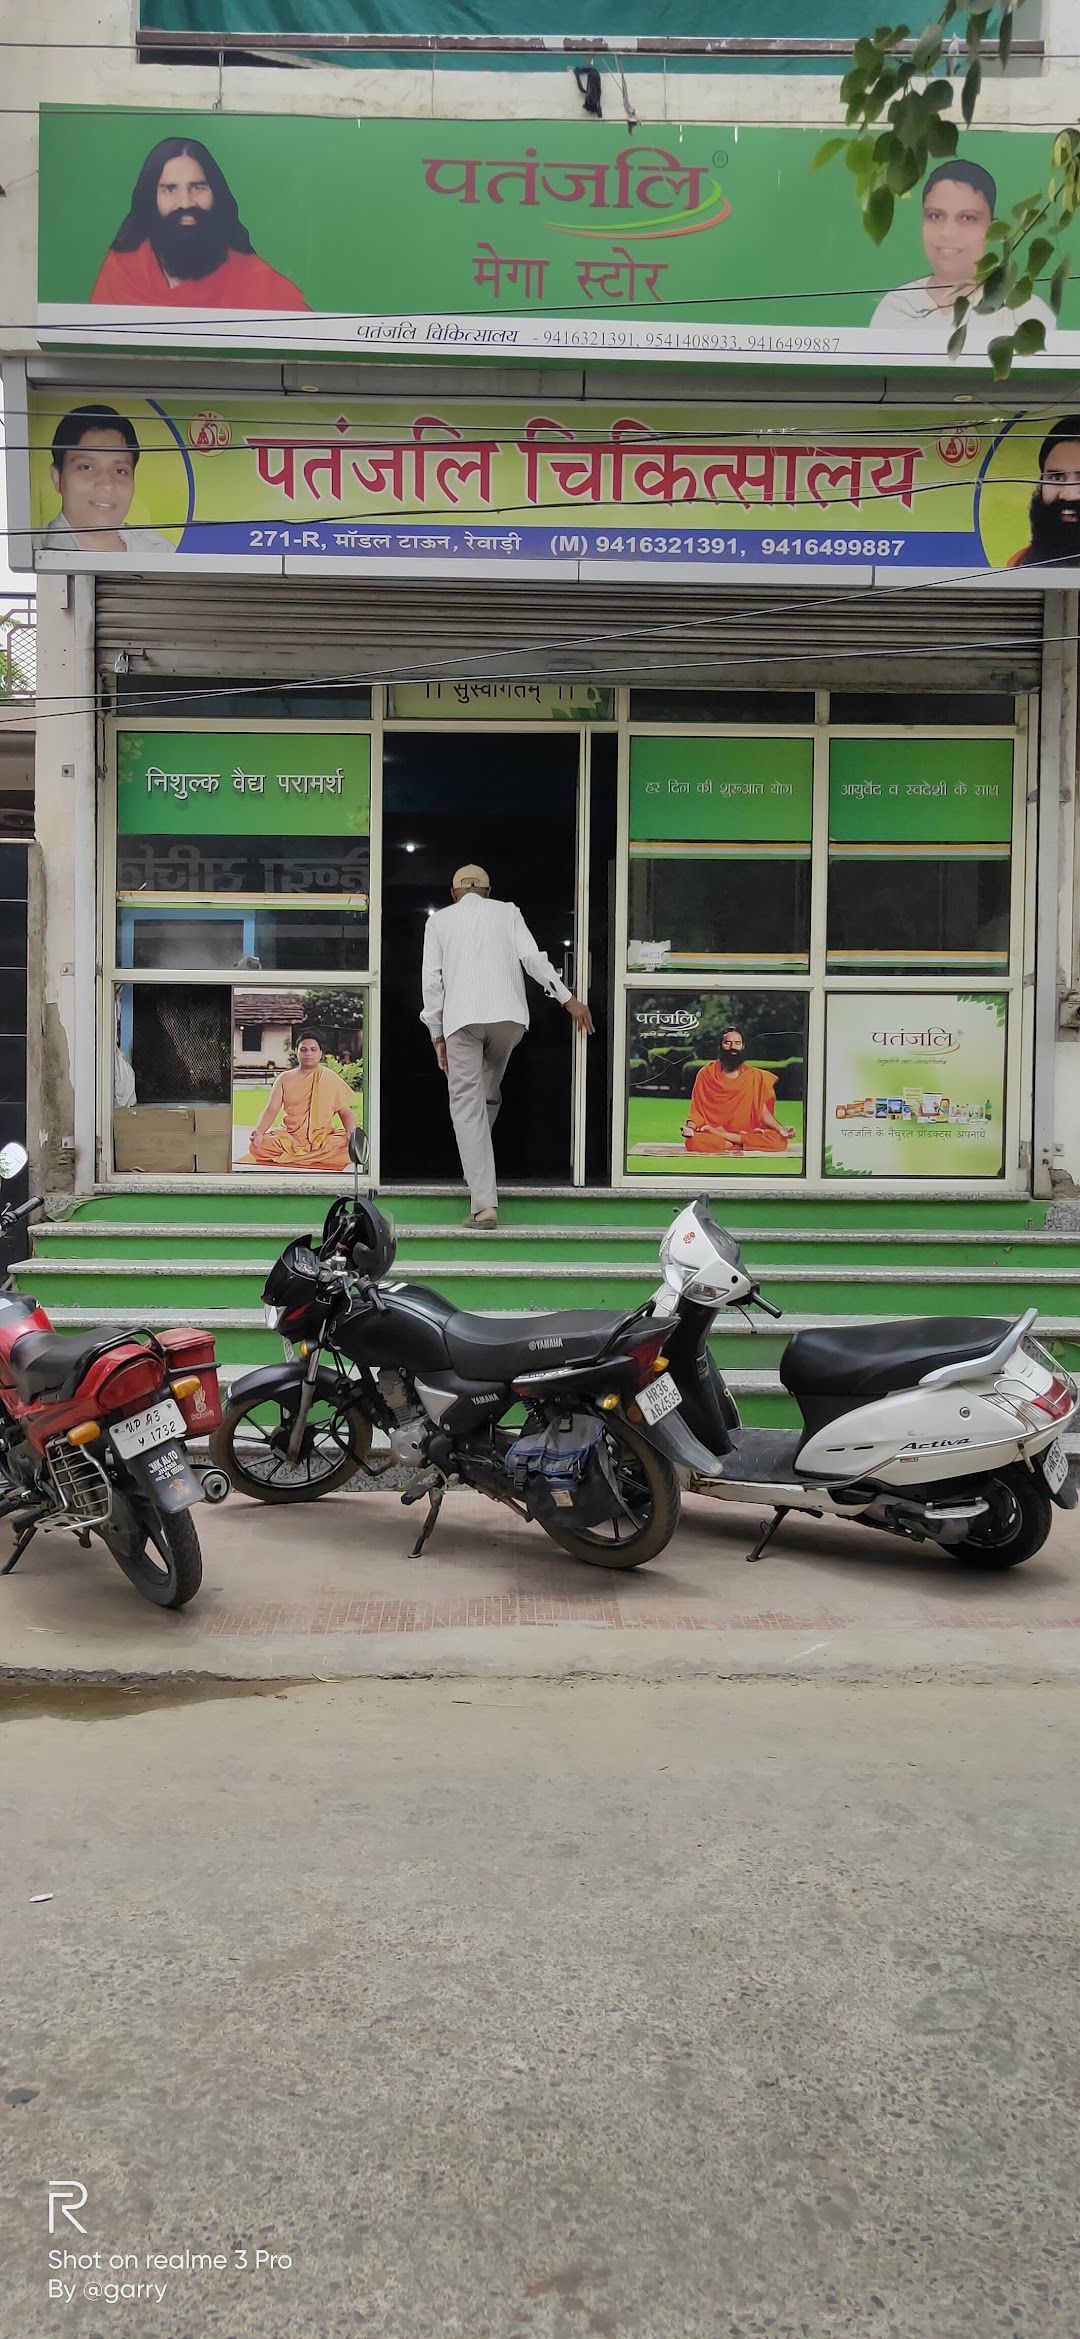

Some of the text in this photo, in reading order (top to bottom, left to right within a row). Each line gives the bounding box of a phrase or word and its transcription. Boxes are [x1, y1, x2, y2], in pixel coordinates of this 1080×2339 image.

[422, 147, 709, 210] पतंजलि
[472, 242, 669, 302] मेगा स्टोर
[357, 321, 417, 340] पतंजलि
[426, 322, 519, 343] चिकित्सालय
[748, 336, 840, 353] 9416499887
[244, 415, 926, 511] पतंजलि चिकित्सालय
[250, 530, 327, 551] 271-R,
[333, 530, 391, 549] मॉडल
[464, 531, 523, 555] रेवाड़ी
[550, 535, 588, 555] (M)
[596, 536, 746, 558] 9416321391,
[761, 538, 905, 557] 9416499887
[145, 766, 345, 800] निशुल्क वैद्य परामर्श
[645, 781, 660, 794] हर
[667, 779, 690, 794] दिन
[696, 780, 712, 794] की
[771, 780, 793, 795] योग
[840, 780, 1000, 799] आयुर्वेद व स्वदेशी के साथ
[635, 1010, 694, 1025] पतंजलि
[871, 1027, 953, 1046] पतंजलि
[875, 1127, 885, 1138] के
[535, 1337, 563, 1350] YAMAHA
[471, 1393, 500, 1405] YAMAHA
[645, 1380, 669, 1404] HR36
[650, 1388, 681, 1421] AB4535
[150, 1420, 176, 1442] 1732
[899, 1438, 972, 1451] Activa
